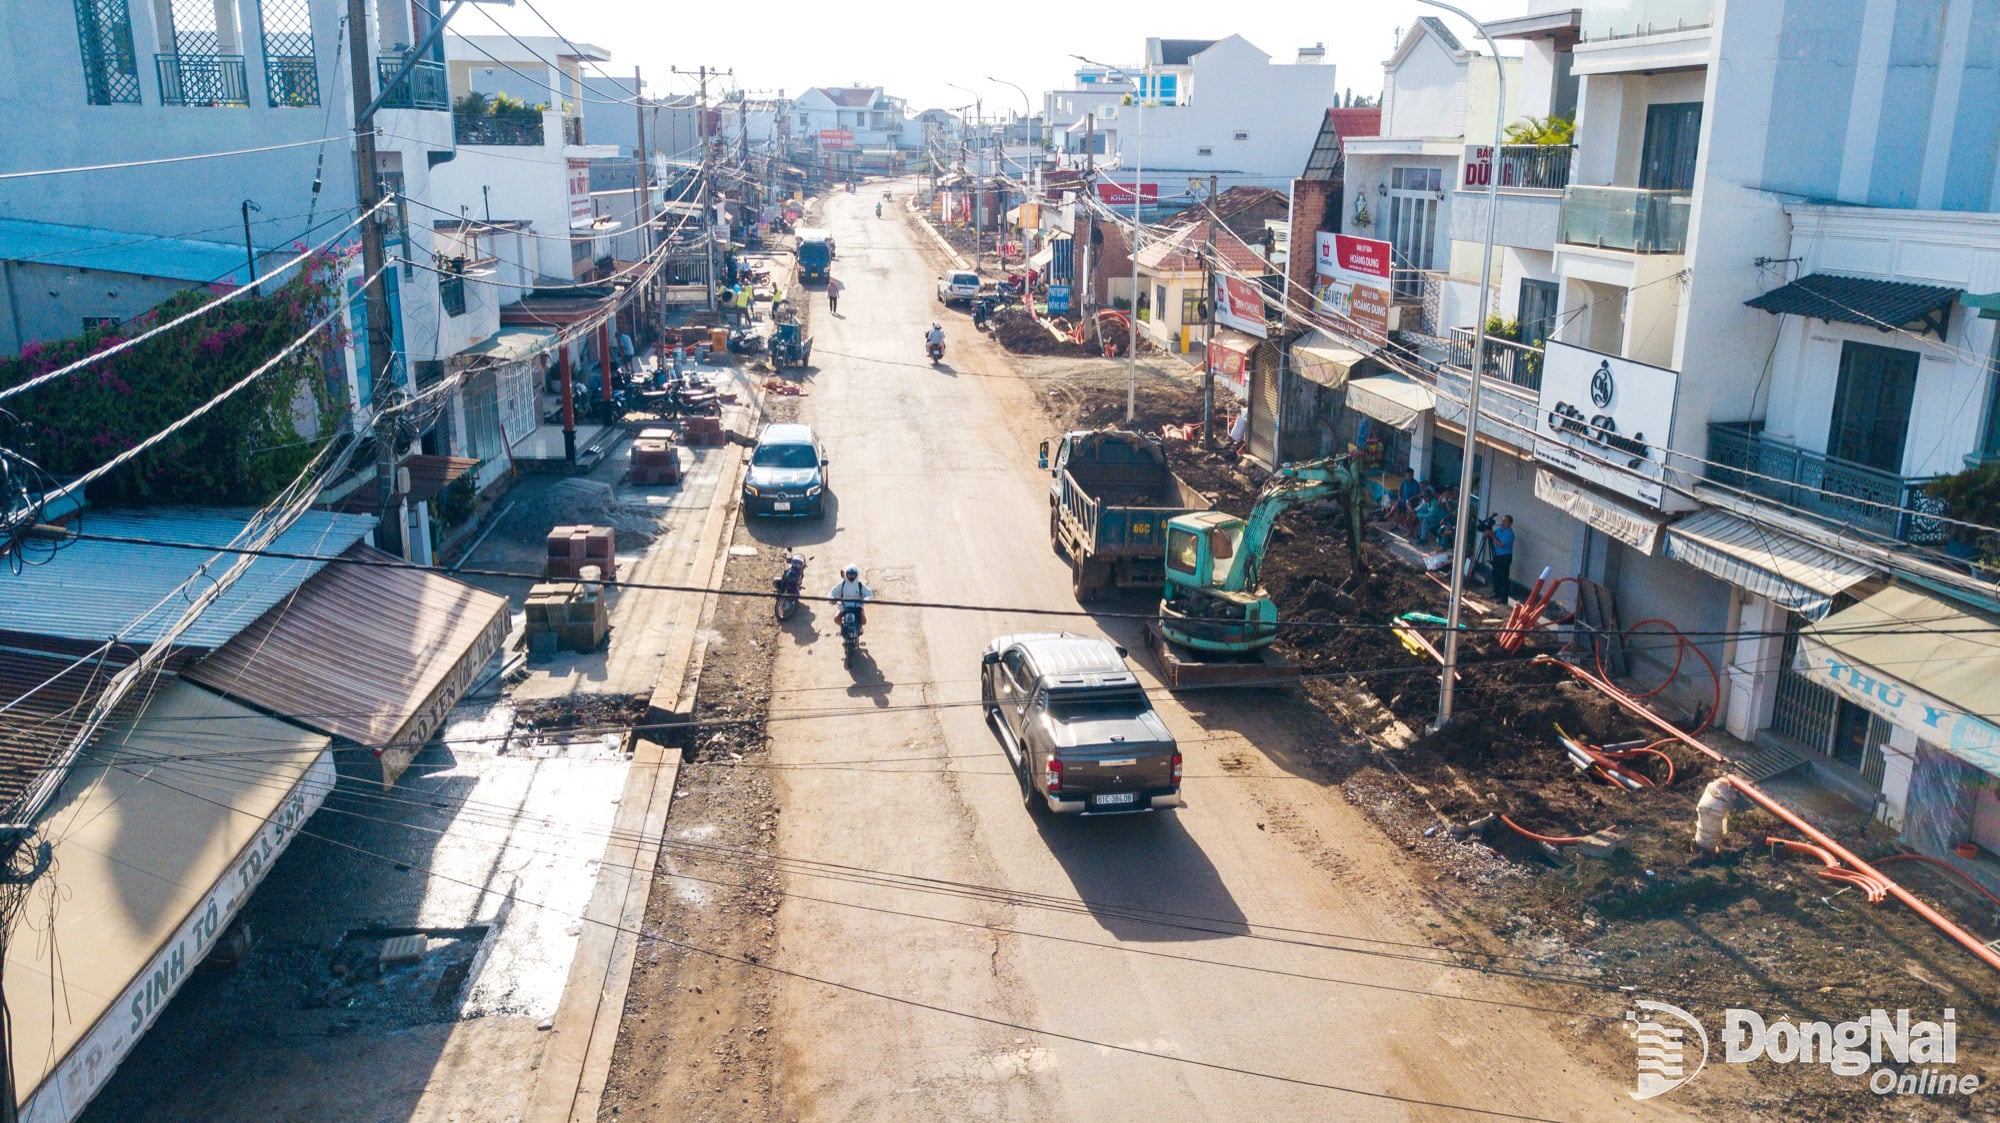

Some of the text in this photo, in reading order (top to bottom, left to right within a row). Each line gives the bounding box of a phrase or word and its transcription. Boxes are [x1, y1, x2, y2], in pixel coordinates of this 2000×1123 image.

[1825, 657, 1907, 709] THÚ
[1920, 701, 1949, 729] Y
[131, 940, 185, 1035] SINH
